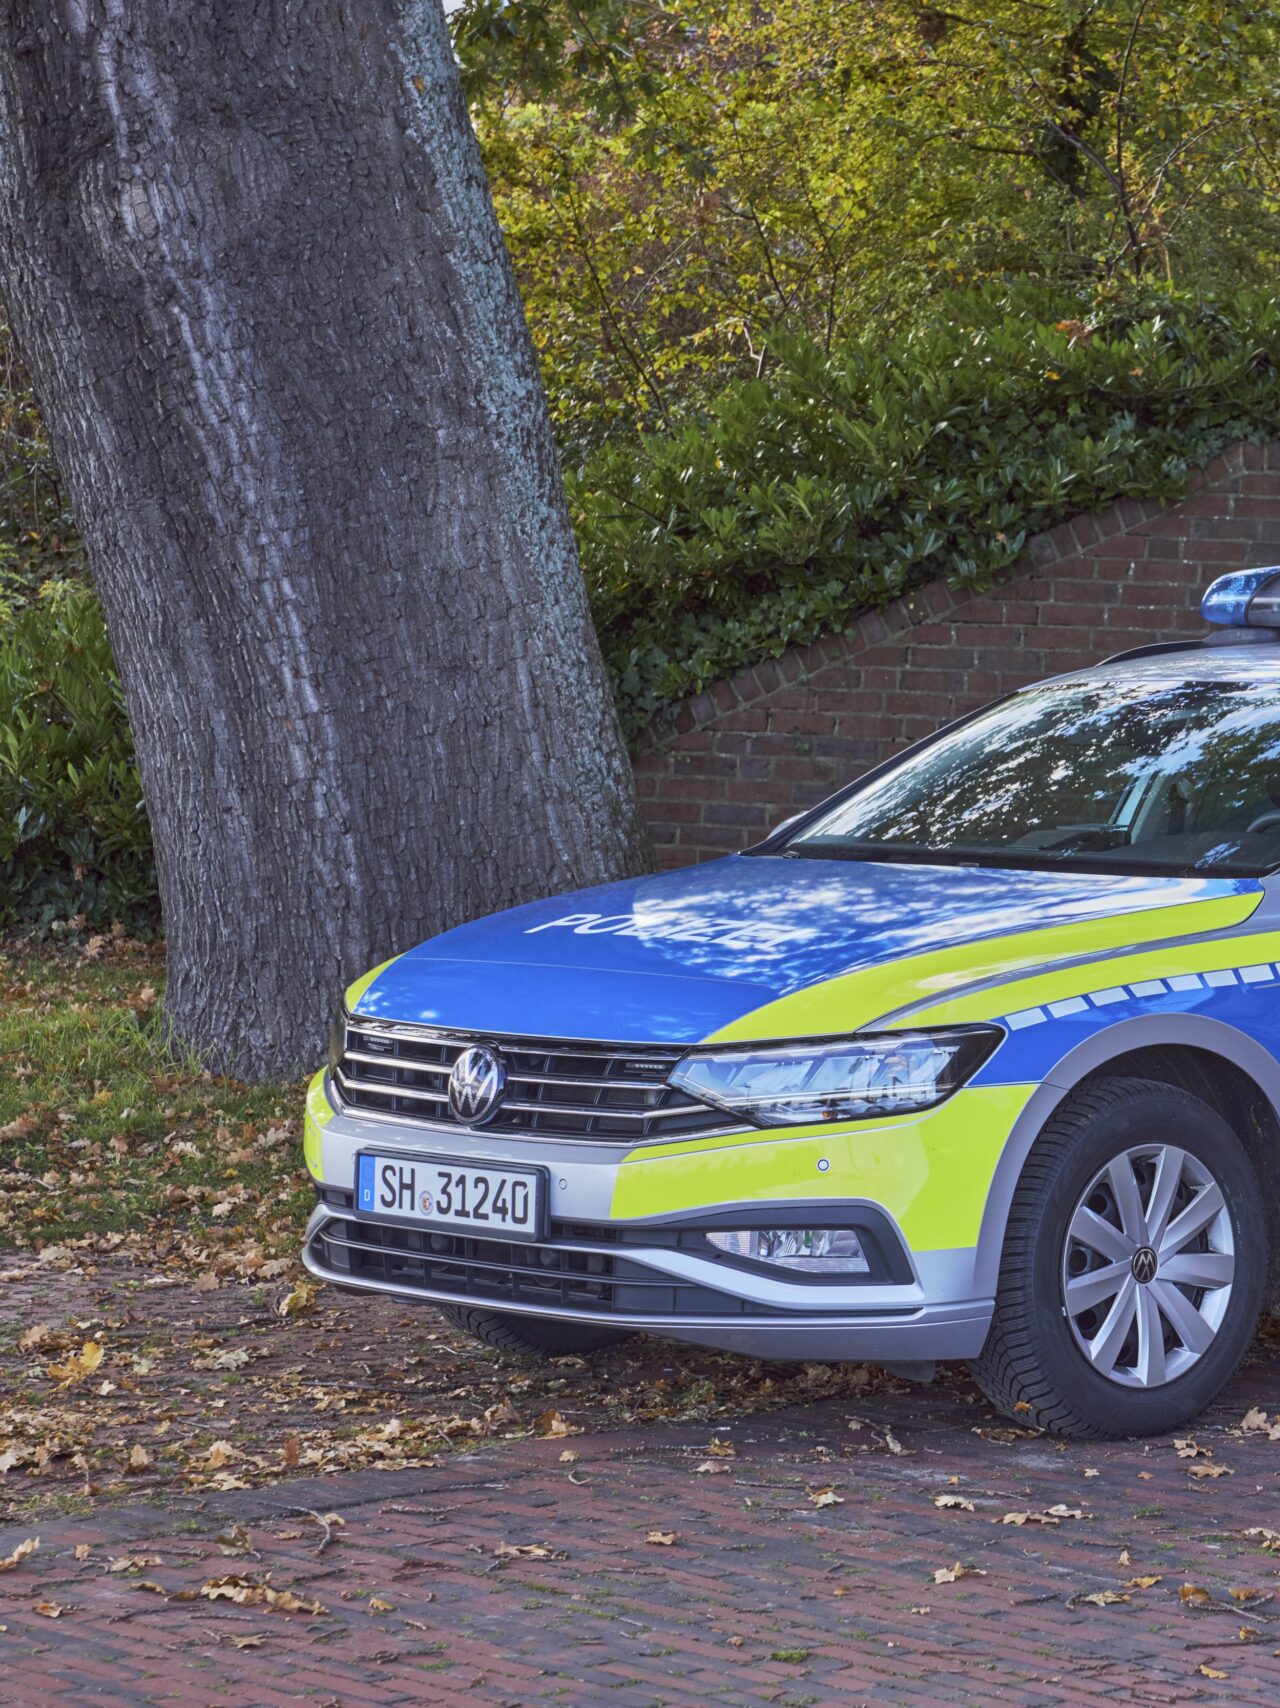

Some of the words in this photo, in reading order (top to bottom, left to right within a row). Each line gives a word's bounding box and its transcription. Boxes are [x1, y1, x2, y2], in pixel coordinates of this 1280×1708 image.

[524, 914, 816, 950] POLIZEI
[449, 1046, 498, 1120] VW
[364, 1189, 371, 1202] D
[380, 1165, 416, 1211] SH
[436, 1171, 529, 1225] 31240
